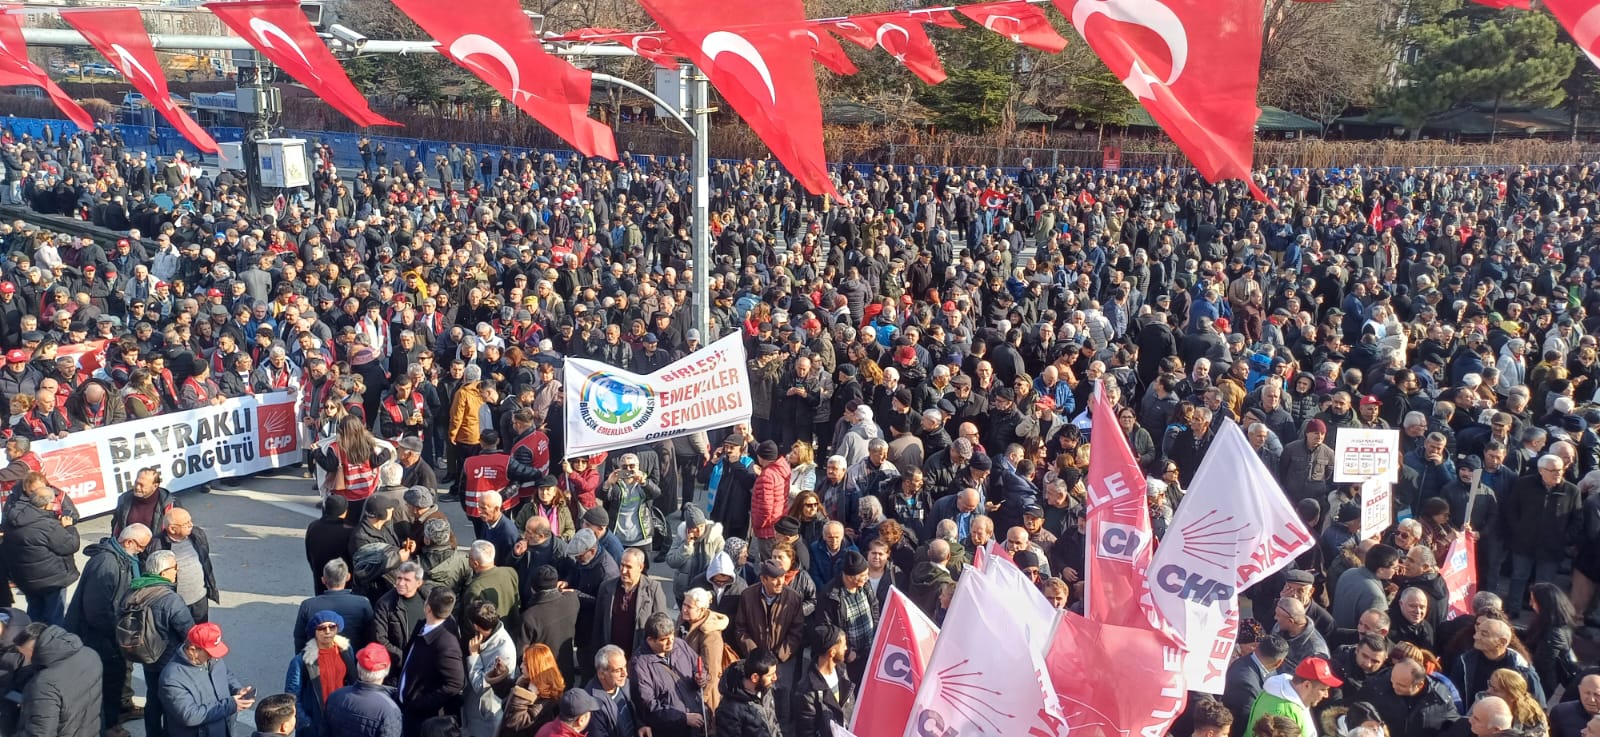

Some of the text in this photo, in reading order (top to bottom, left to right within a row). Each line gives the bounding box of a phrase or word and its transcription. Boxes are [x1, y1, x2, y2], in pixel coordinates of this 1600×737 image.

[660, 348, 728, 382] BİRLEŞİ
[597, 425, 633, 435] EMEKLİLER
[632, 398, 655, 429] SENDİKASI
[660, 392, 743, 429] SENDİKASI
[108, 407, 252, 465] BAYRAKLI
[264, 434, 293, 450] CHP
[171, 440, 255, 479] ÖRGÜTÜ
[1087, 471, 1131, 513] LE
[1156, 563, 1235, 608] CHP
